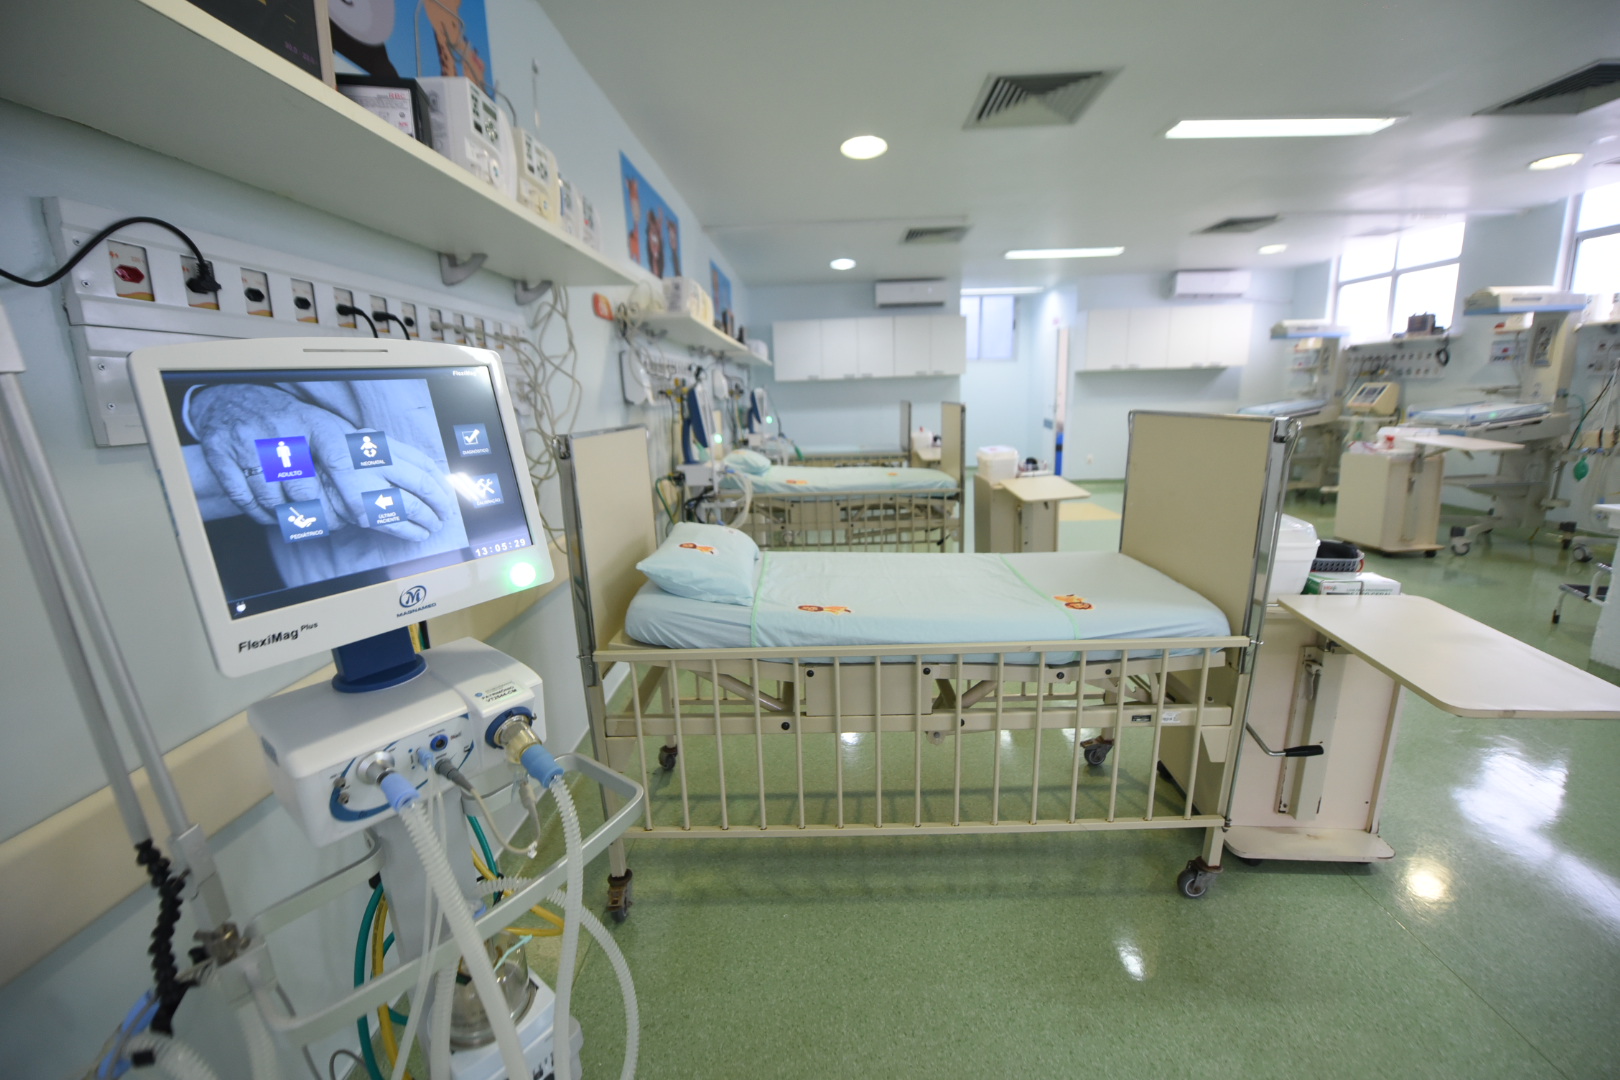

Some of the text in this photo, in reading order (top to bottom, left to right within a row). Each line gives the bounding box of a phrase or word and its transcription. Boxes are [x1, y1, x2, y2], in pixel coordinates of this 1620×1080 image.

[360, 459, 385, 467] NEONATAL
[278, 470, 302, 478] ADULTO
[377, 516, 400, 525] PACIENTE
[290, 529, 324, 540] PEDIÁTRICO
[475, 538, 526, 557] 13:05:29
[396, 602, 437, 618] MAGNAMED
[238, 621, 318, 653] FlexiMag Plus
